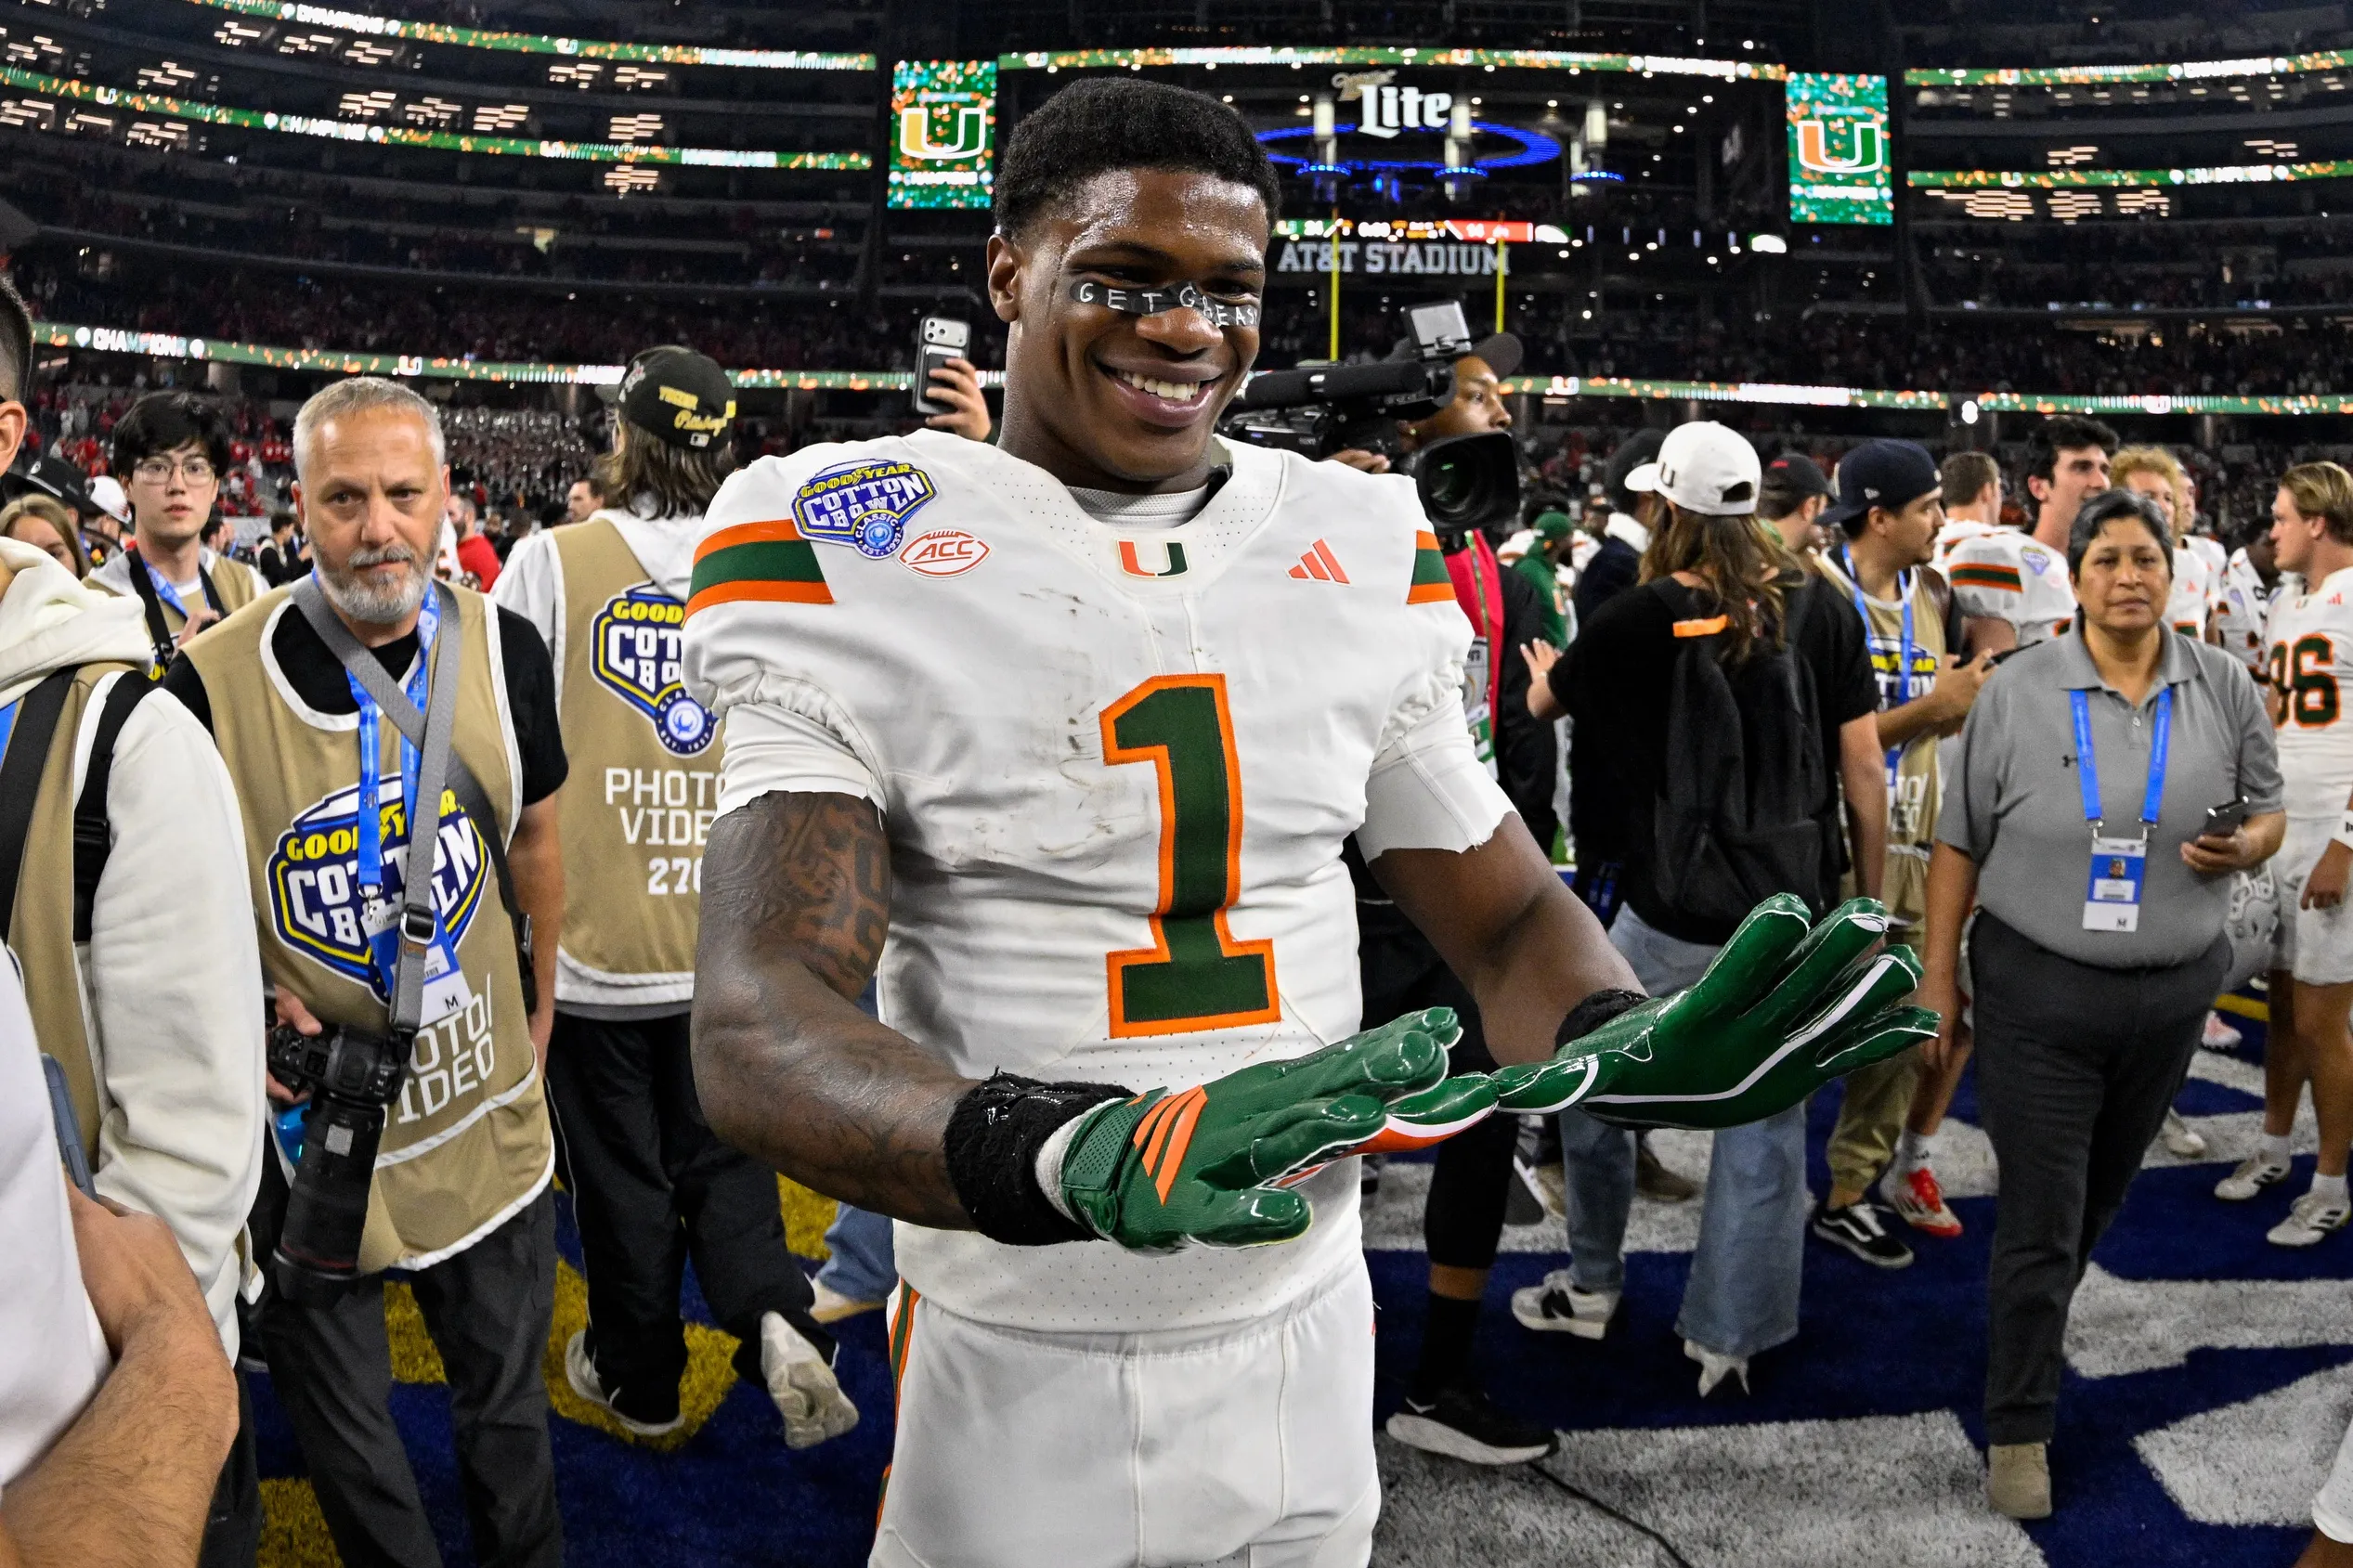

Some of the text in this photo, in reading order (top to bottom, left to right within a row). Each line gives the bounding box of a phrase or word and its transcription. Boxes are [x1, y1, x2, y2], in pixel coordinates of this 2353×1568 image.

[1358, 84, 1452, 138] Lite
[900, 108, 986, 159] U
[1797, 121, 1882, 173] U
[1277, 242, 1511, 275] AT&T STADIUM
[1080, 283, 1163, 312] GET
[93, 328, 187, 357] CHAMPIONS
[801, 464, 911, 498] GOODYEAR
[802, 472, 926, 527] COTTON
[830, 494, 907, 527] BOWL
[855, 512, 899, 538] CLASSIC
[914, 540, 974, 560] ACC
[1116, 538, 1189, 579] U
[613, 600, 684, 624] GOOD
[1098, 673, 1282, 1039] 1
[444, 994, 459, 1011] M
[397, 1033, 495, 1125] IDEO
